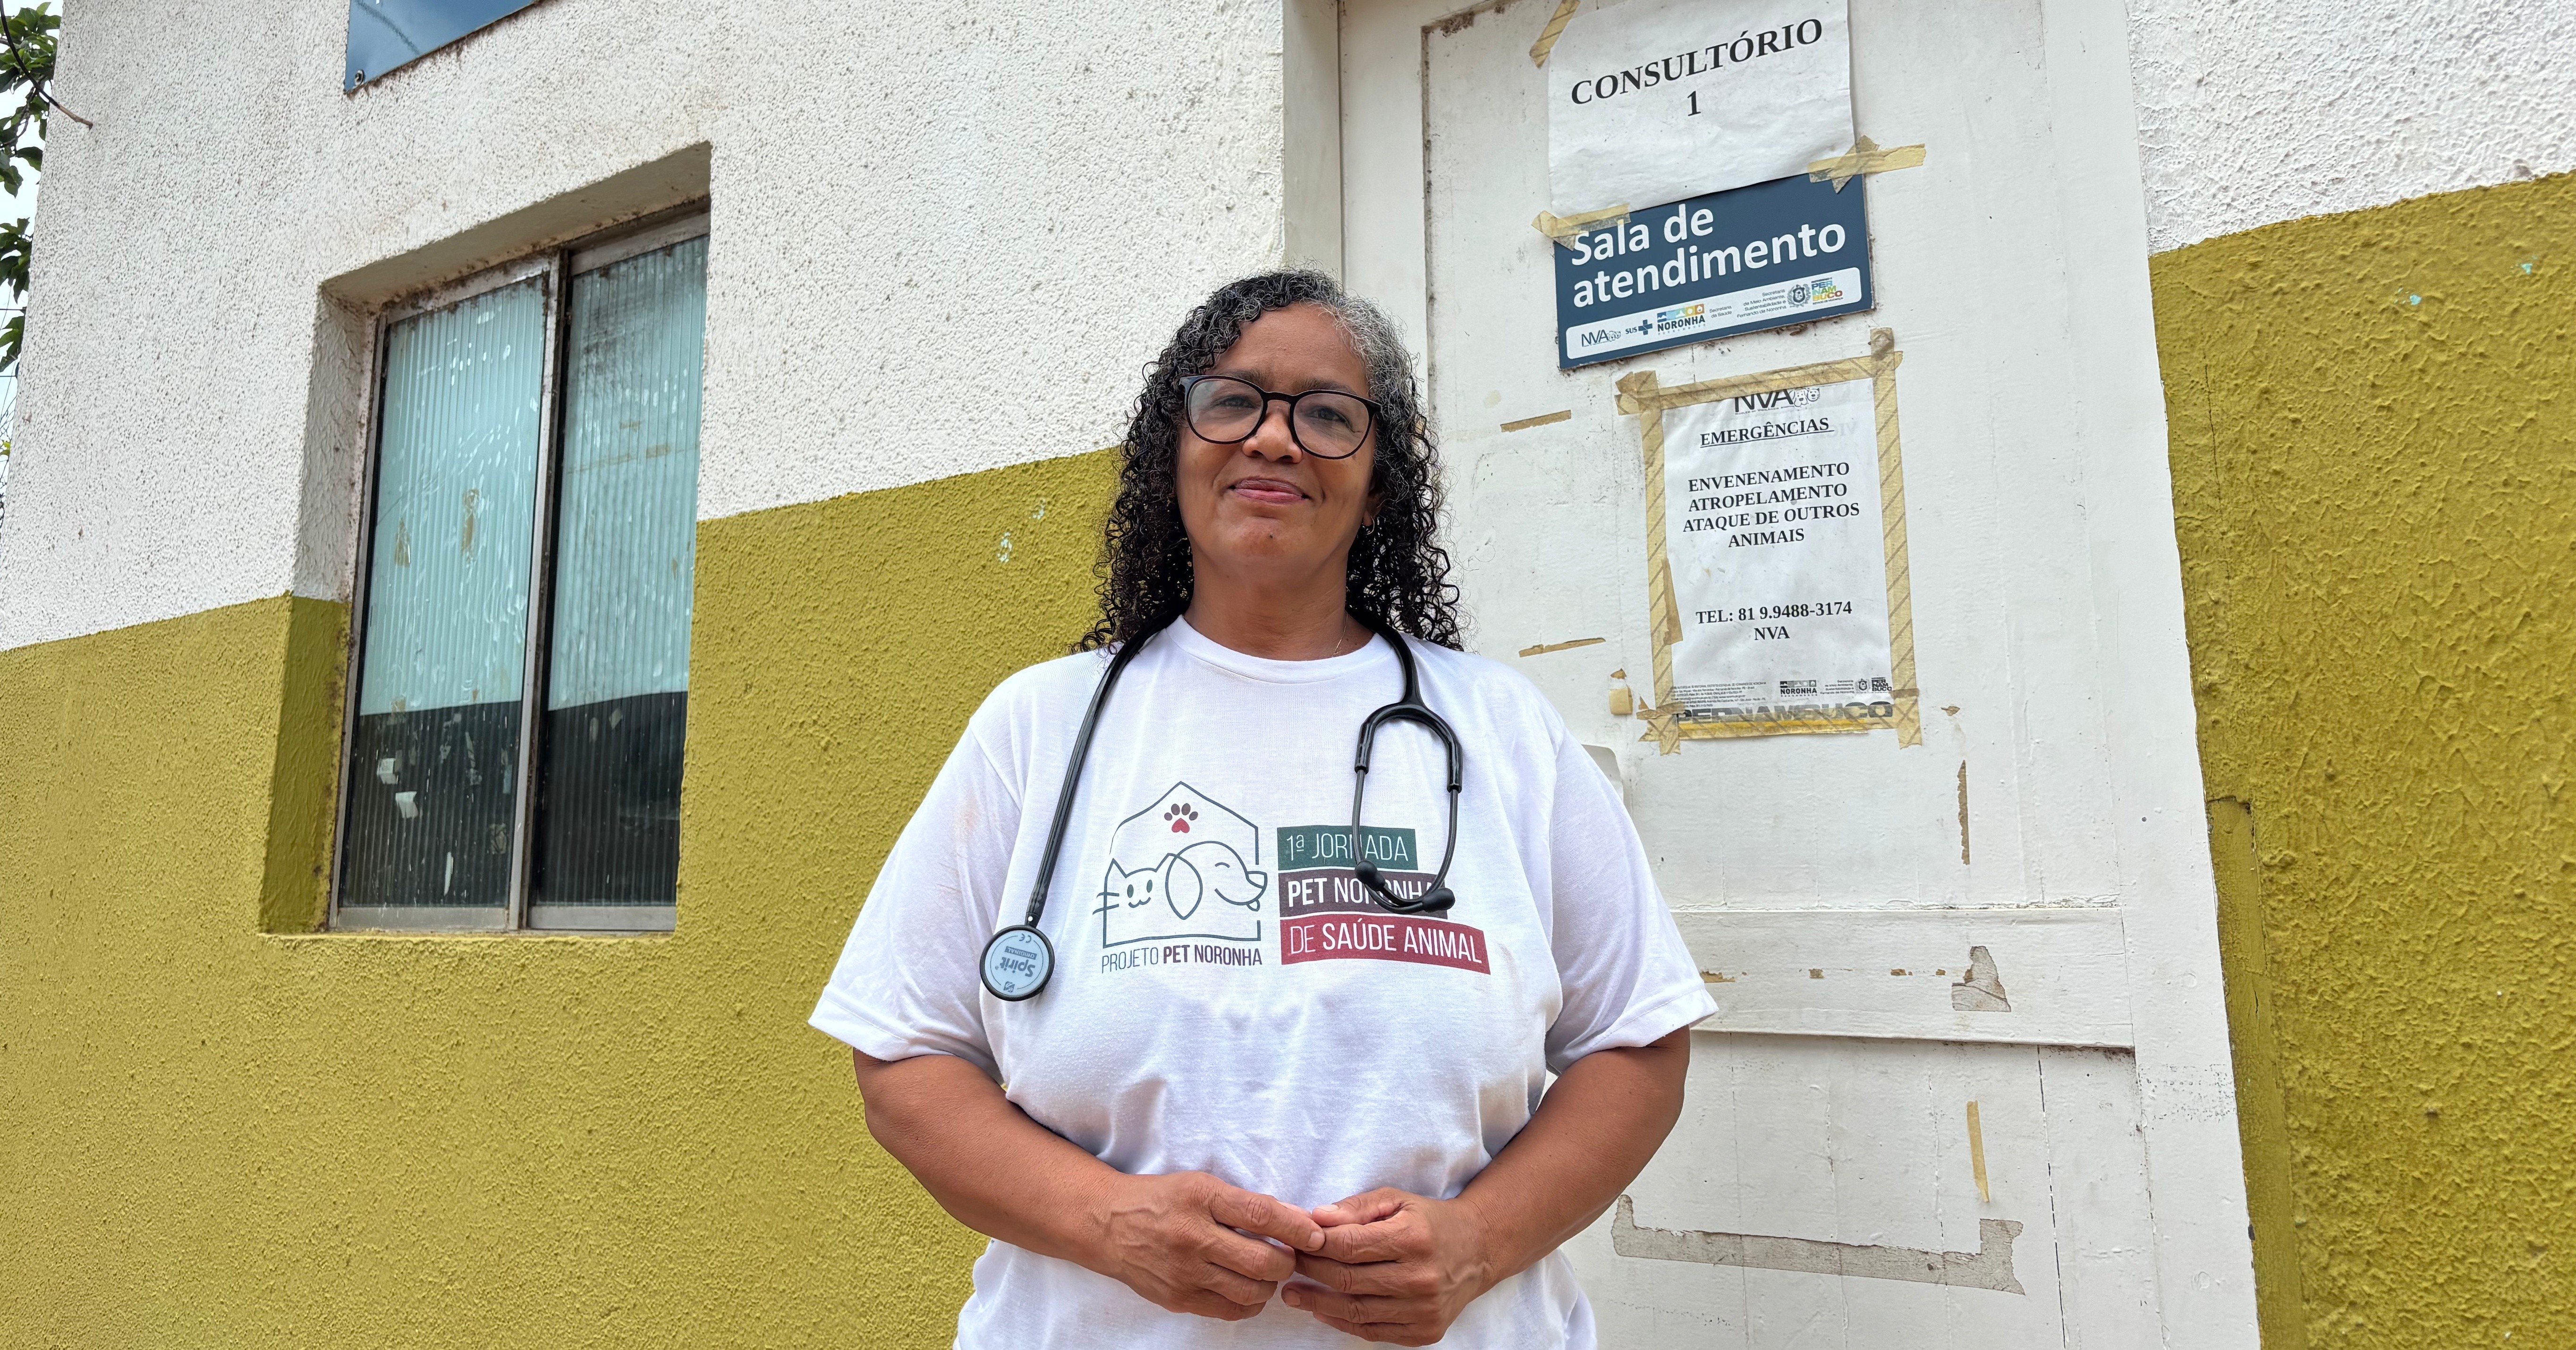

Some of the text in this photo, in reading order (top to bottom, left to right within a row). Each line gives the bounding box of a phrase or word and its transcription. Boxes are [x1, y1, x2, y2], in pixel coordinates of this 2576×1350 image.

[1571, 18, 1822, 105] CONSULTÓRIO
[1687, 91, 1701, 116] 1
[1572, 204, 1713, 265] Sala de
[1574, 223, 1846, 307] atendimento
[1625, 326, 1637, 334] SUS
[1657, 315, 1705, 331] NORONHA
[1582, 329, 1608, 347] NVA
[1700, 417, 1830, 446] EMERGÊNCIAS
[1688, 462, 1849, 492] ENVENENAMENTO
[1688, 483, 1847, 512] ATROPELAMENTO
[1683, 502, 1860, 532] ATAQUE DE OUTROS
[1728, 528, 1805, 547] ANIMAIS
[1695, 601, 1852, 624] TEL: 81 9.9488-3174
[1754, 626, 1790, 641] NVA
[1287, 834, 1304, 861] 1ª
[1288, 877, 1327, 907] PET
[1290, 918, 1483, 964] DE SAÚDE ANIMAL
[1102, 945, 1263, 974] PROJETO PET NORONHA
